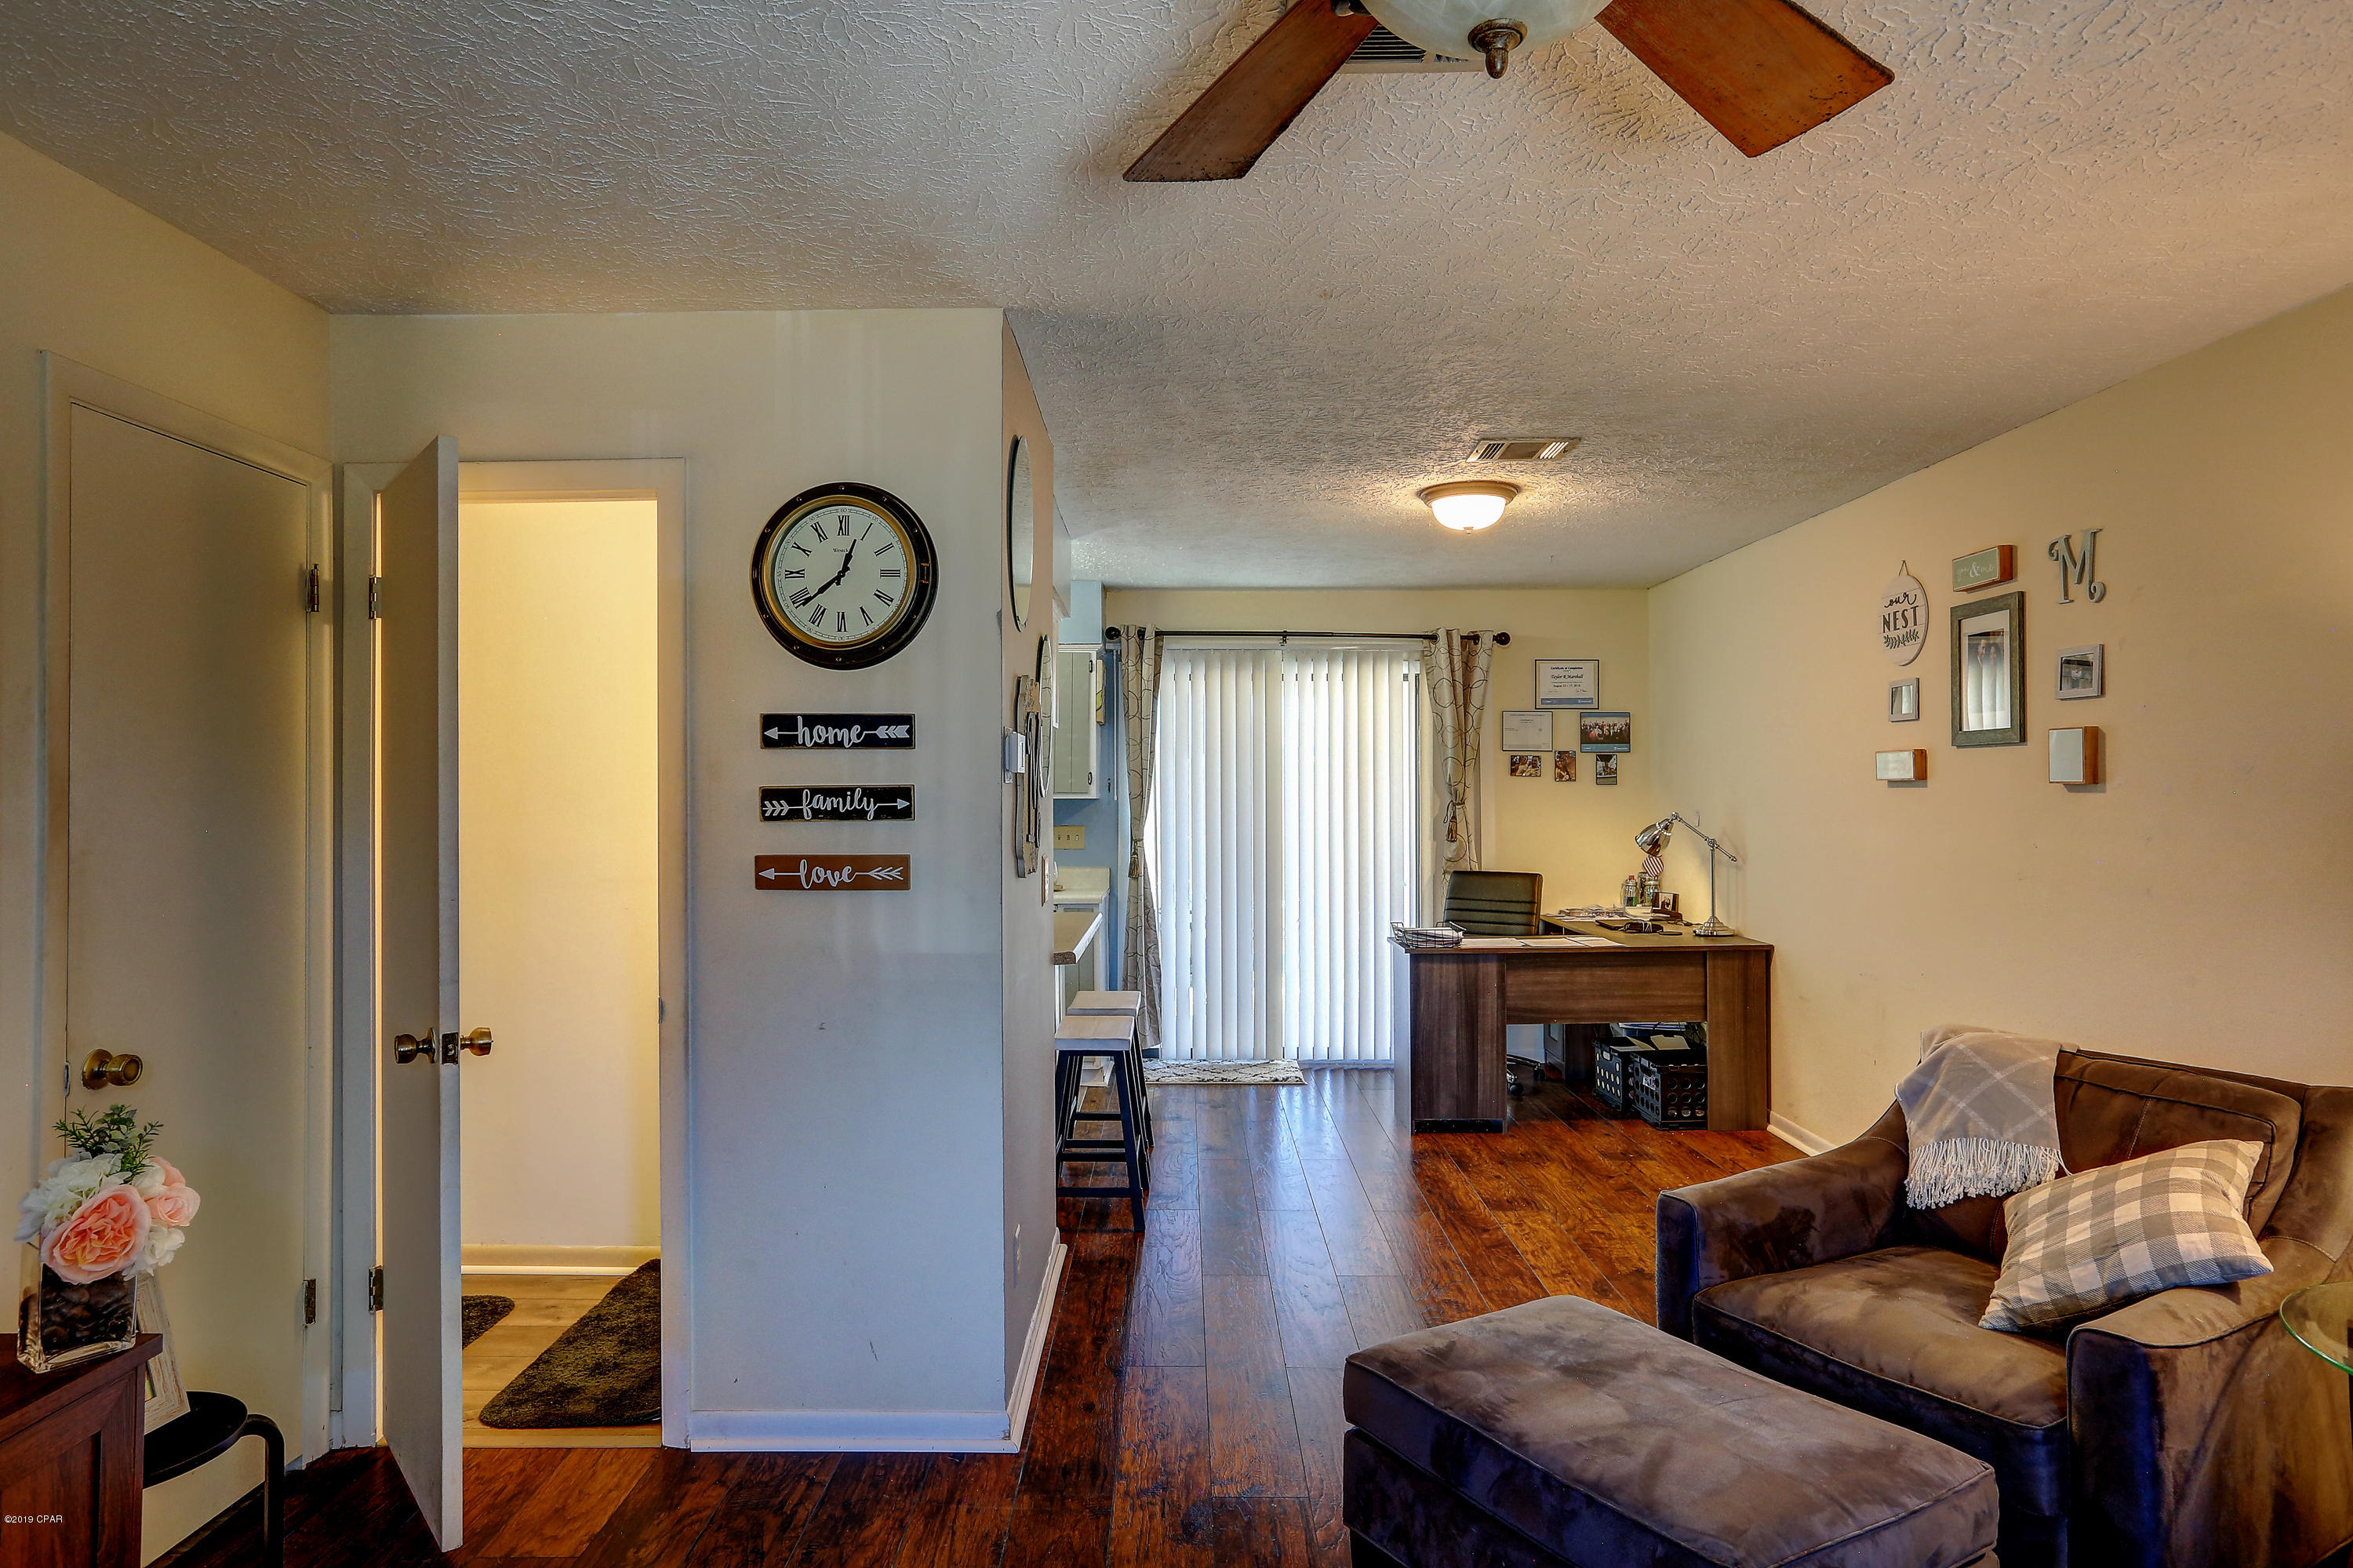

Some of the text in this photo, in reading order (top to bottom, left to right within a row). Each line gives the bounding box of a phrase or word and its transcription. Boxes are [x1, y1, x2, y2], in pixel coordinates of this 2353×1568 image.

[809, 521, 829, 544] XI
[837, 515, 850, 537] XII
[860, 522, 874, 541] I
[791, 540, 813, 558] X
[873, 541, 895, 557] II
[784, 569, 806, 580] IX
[879, 568, 901, 580] III
[1969, 562, 1980, 578] &
[2048, 528, 2106, 604] M
[788, 586, 812, 609] VIII
[872, 588, 895, 608] IV
[1883, 591, 1916, 609] our
[807, 603, 827, 628] VII
[835, 611, 848, 633] VI
[860, 606, 874, 627] V
[1882, 605, 1918, 634] NEST
[797, 715, 864, 748] home
[802, 788, 877, 820] family
[799, 859, 856, 890] love
